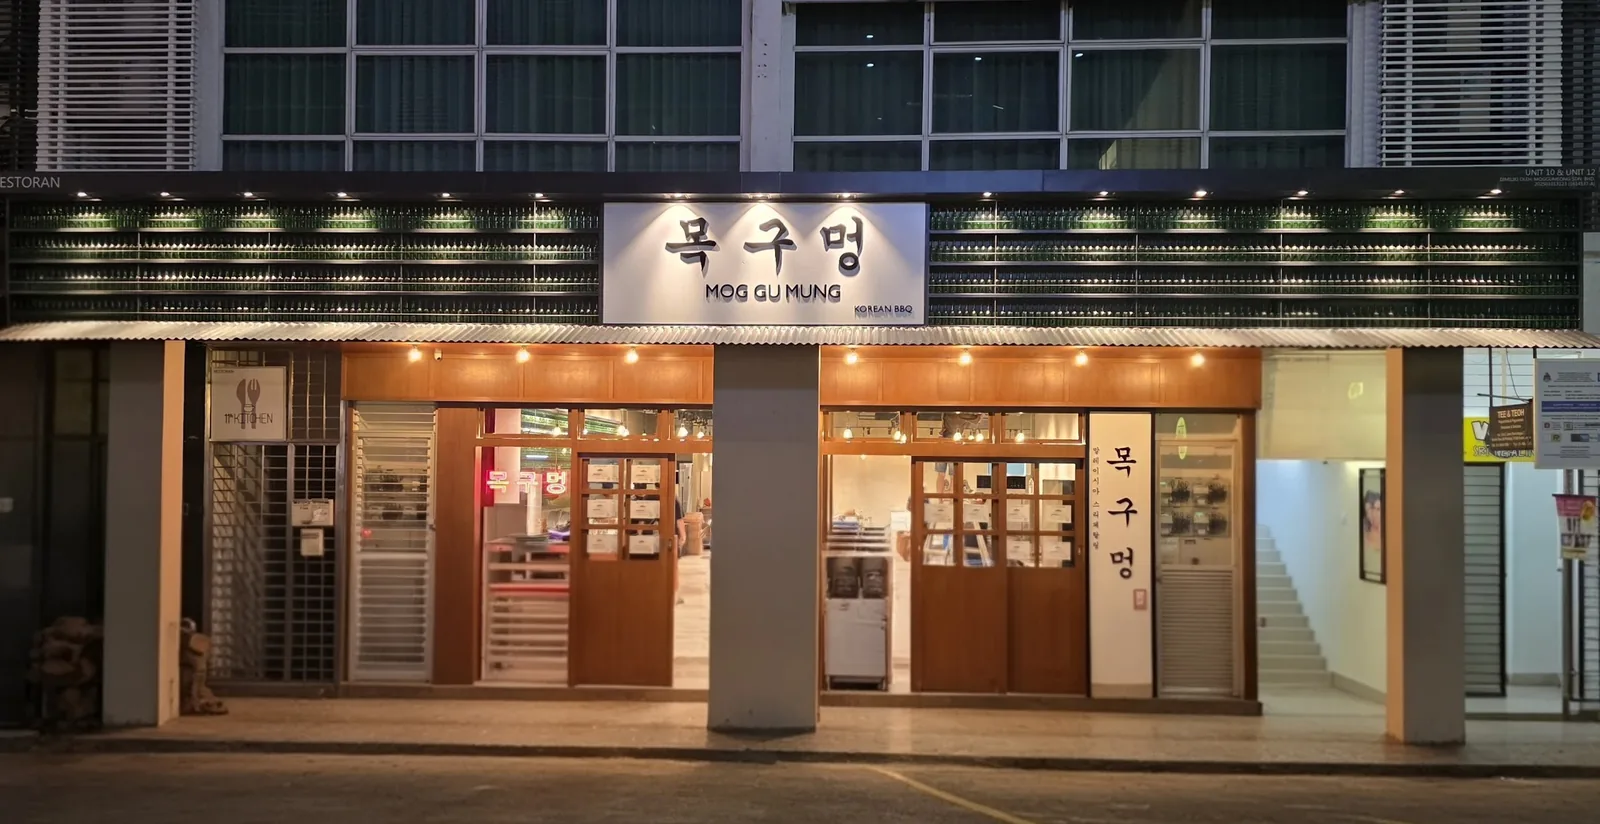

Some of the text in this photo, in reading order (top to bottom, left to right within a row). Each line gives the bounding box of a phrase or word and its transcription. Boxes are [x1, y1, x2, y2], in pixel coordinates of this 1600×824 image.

[1525, 168, 1596, 176] UNIT 10 & UNIT 12
[664, 215, 864, 279] 목구멍
[705, 283, 841, 301] MOG GU MUNG
[854, 304, 913, 314] KOREAN BBQ
[1497, 410, 1507, 418] TEE
[486, 470, 566, 495] 목구멍
[1106, 446, 1138, 580] 목구멍
